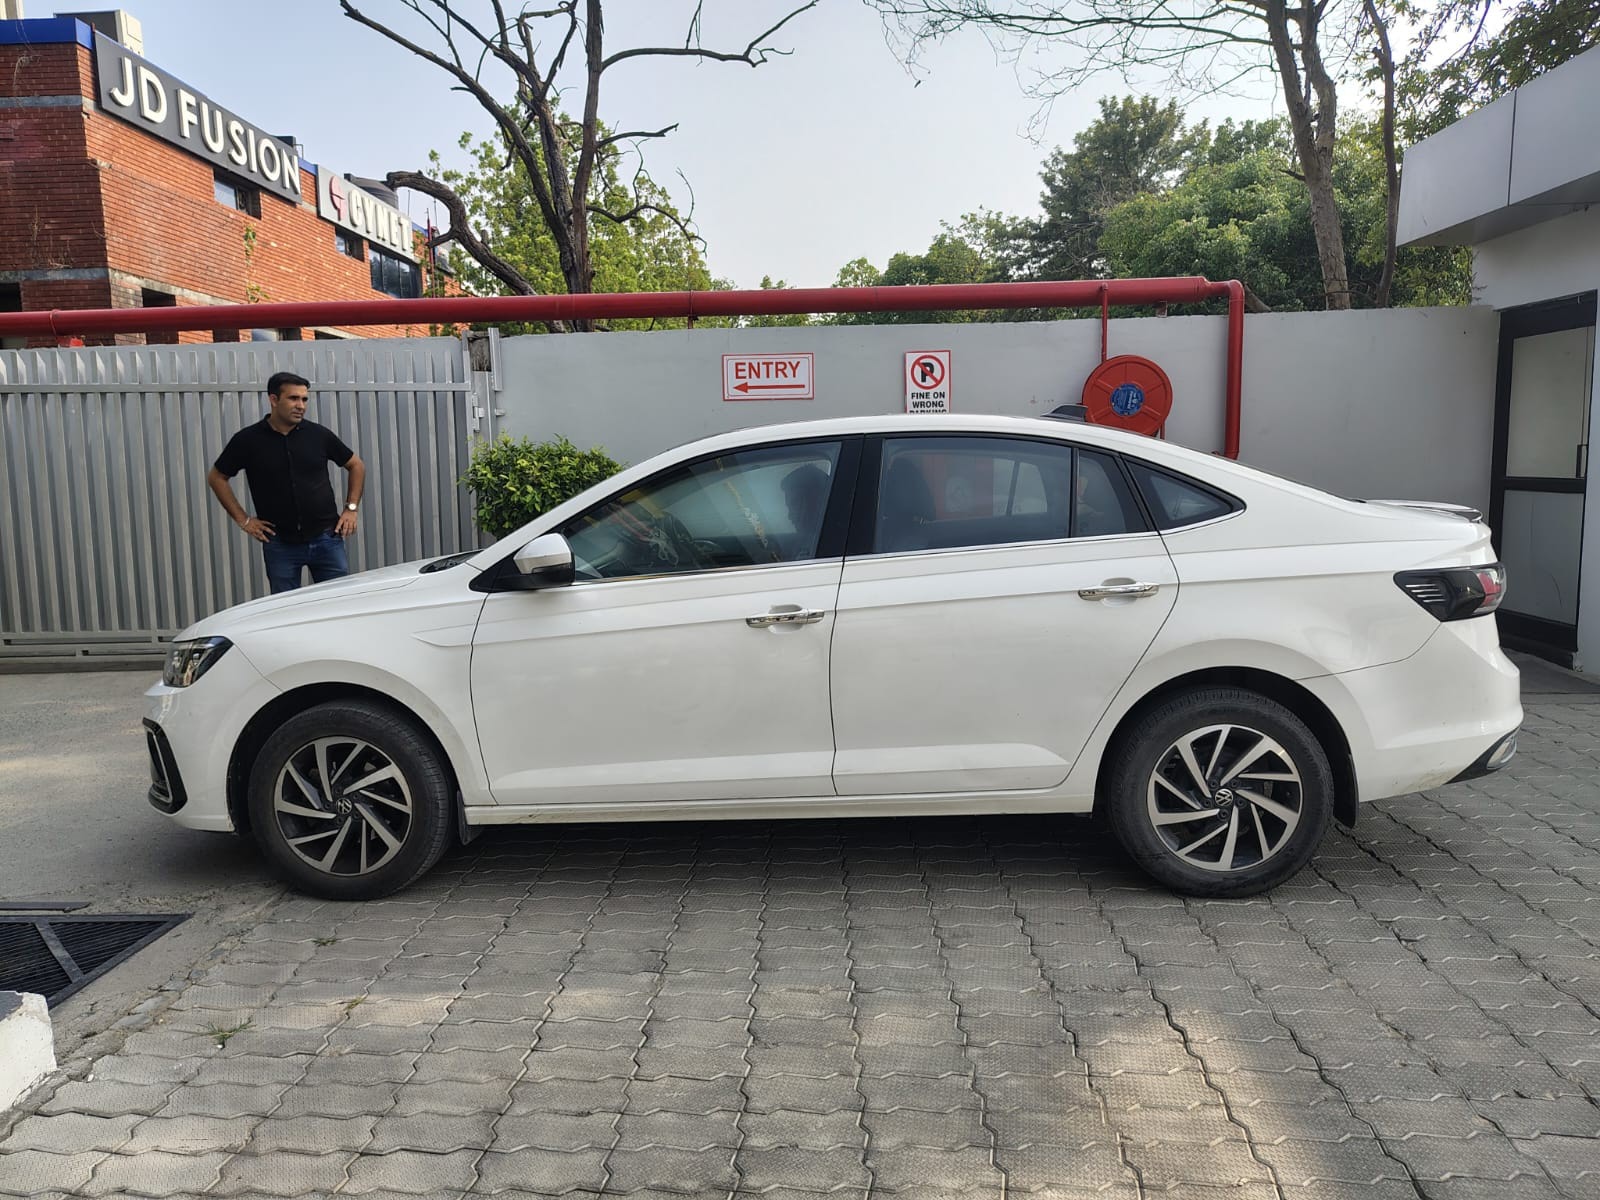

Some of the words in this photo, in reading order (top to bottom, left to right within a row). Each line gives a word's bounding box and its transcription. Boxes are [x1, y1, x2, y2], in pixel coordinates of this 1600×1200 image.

[109, 56, 168, 124] JD
[176, 88, 300, 194] FUSION
[734, 360, 801, 380] ENTRY
[920, 362, 935, 383] P
[911, 391, 931, 400] FINE
[932, 391, 946, 400] ON
[912, 400, 945, 409] WRONG
